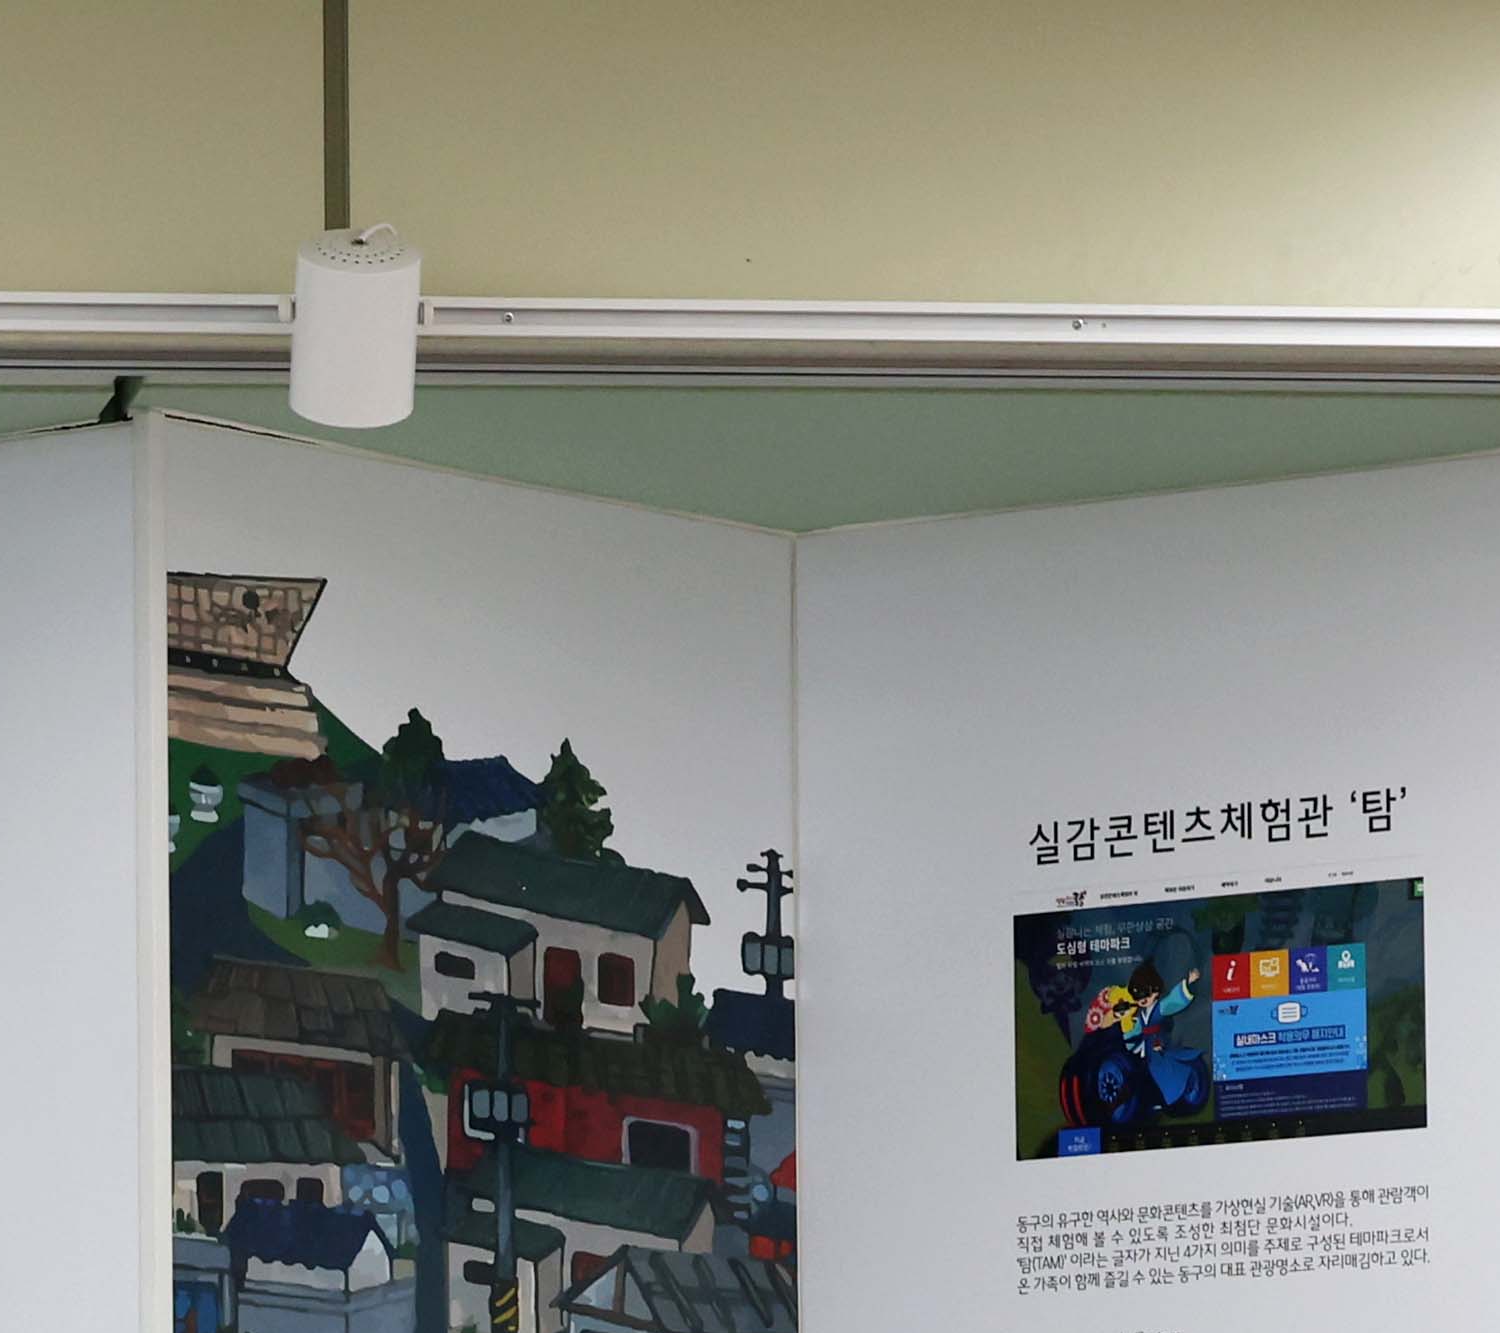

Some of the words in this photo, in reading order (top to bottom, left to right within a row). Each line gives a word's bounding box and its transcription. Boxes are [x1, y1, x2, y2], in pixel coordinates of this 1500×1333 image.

[1028, 794, 1334, 866] 실감콘텐츠체험관
[1089, 937, 1131, 954] 테마파크
[1016, 1212, 1054, 1235] 동구의
[1056, 1209, 1095, 1230] 유구한
[1096, 1207, 1134, 1227] 역사와
[1137, 1201, 1213, 1225] 문화콘텐츠를
[1216, 1196, 1266, 1218] 가상현실
[1269, 1190, 1346, 1213] 기술(AR,VR)을
[1347, 1188, 1375, 1209] 통해
[1377, 1184, 1429, 1206] 관람객이
[1017, 1235, 1043, 1254] 직접
[1048, 1232, 1088, 1251] 체험해
[1093, 1230, 1106, 1249] 볼
[1111, 1229, 1124, 1245] 수
[1129, 1224, 1168, 1246] 있도록
[1174, 1221, 1216, 1242] 조성한
[1220, 1218, 1262, 1238] 최첨단
[1264, 1211, 1353, 1236] 문화시설이다.
